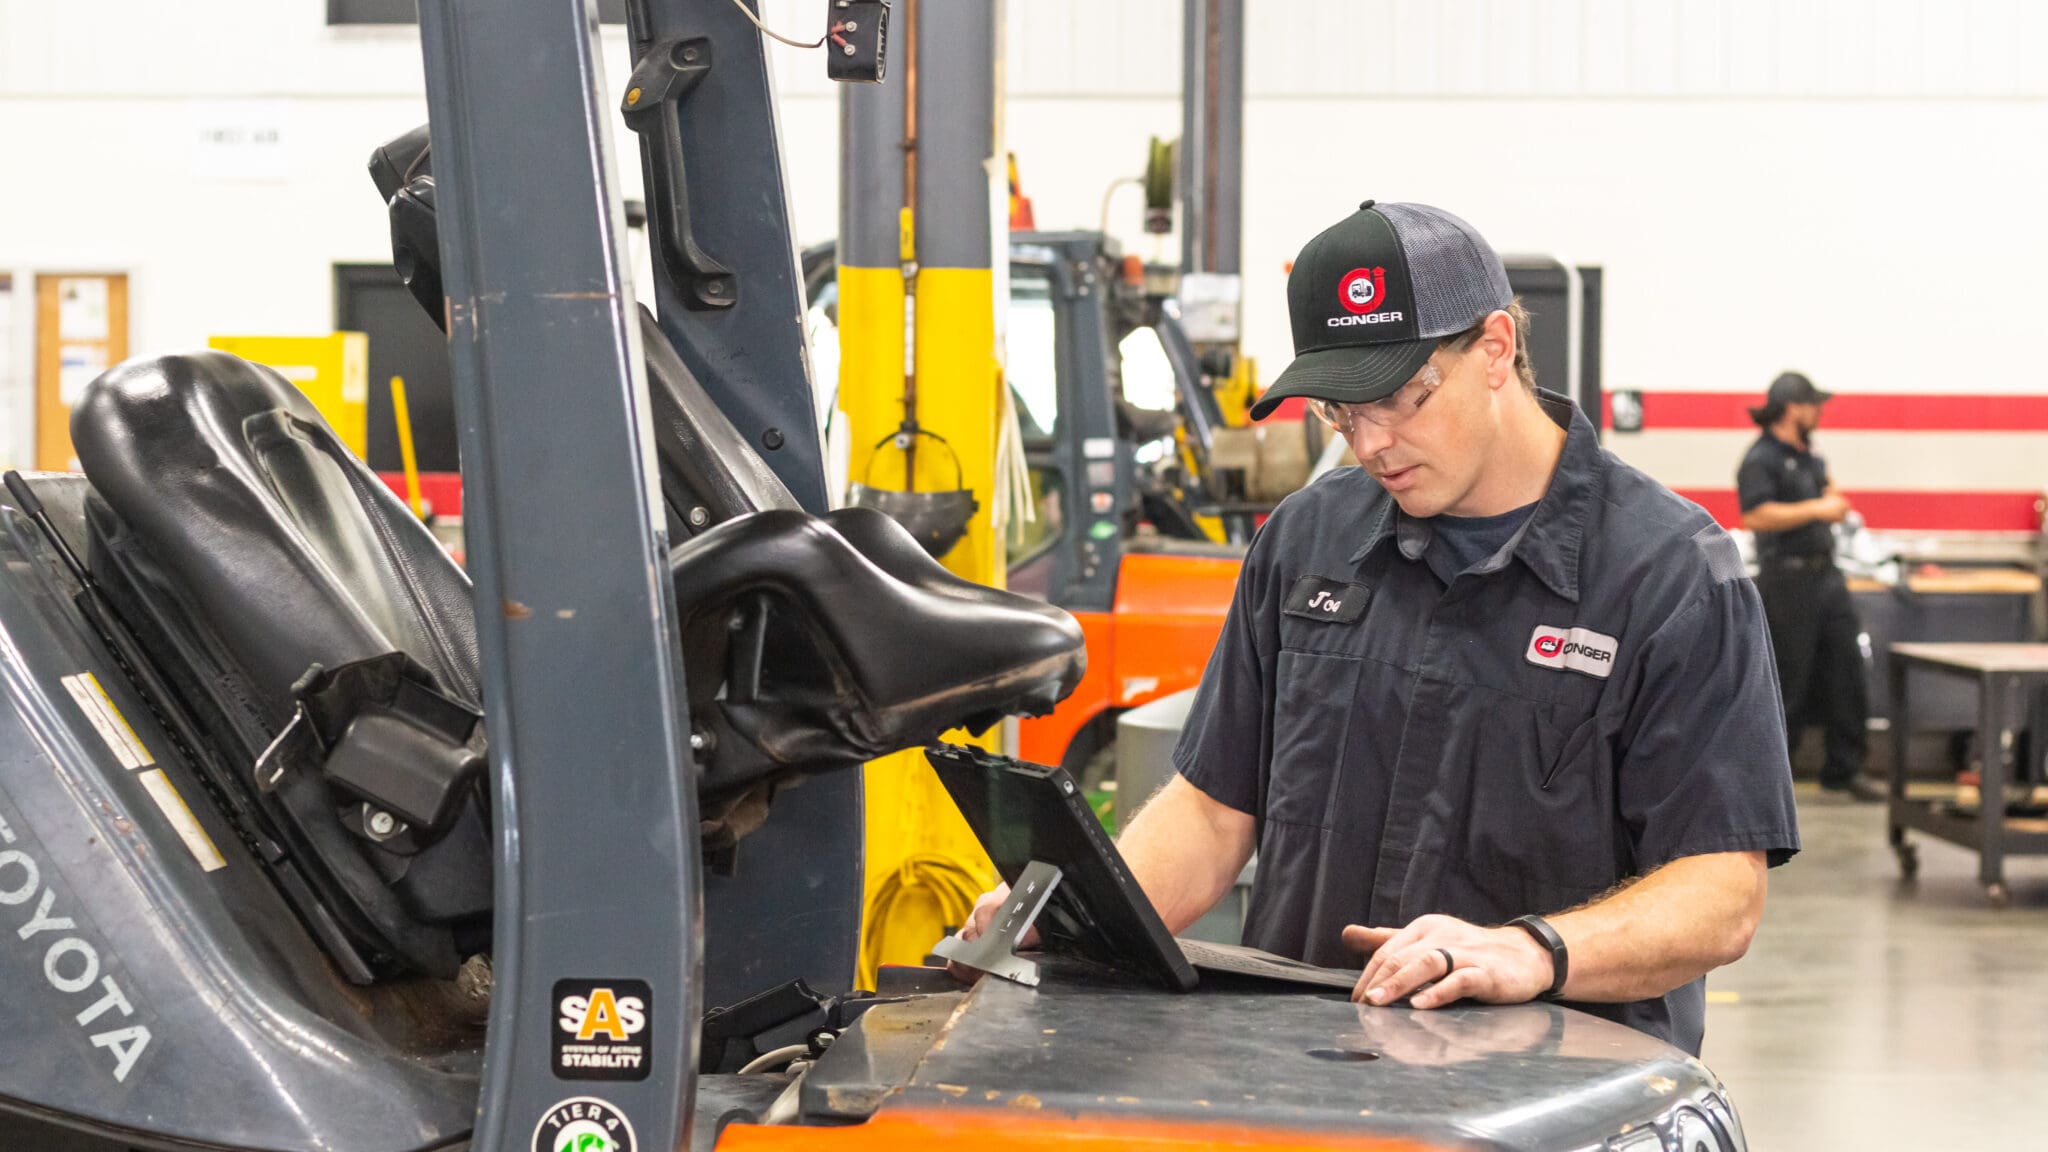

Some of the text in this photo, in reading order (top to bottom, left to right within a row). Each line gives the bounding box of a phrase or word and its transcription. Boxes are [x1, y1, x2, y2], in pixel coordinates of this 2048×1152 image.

[1327, 311, 1403, 327] CONGER
[1563, 642, 1611, 662] ONGER
[559, 988, 645, 1041] SAS
[562, 1054, 642, 1068] STABILITY
[547, 1103, 619, 1131] TIER 4
